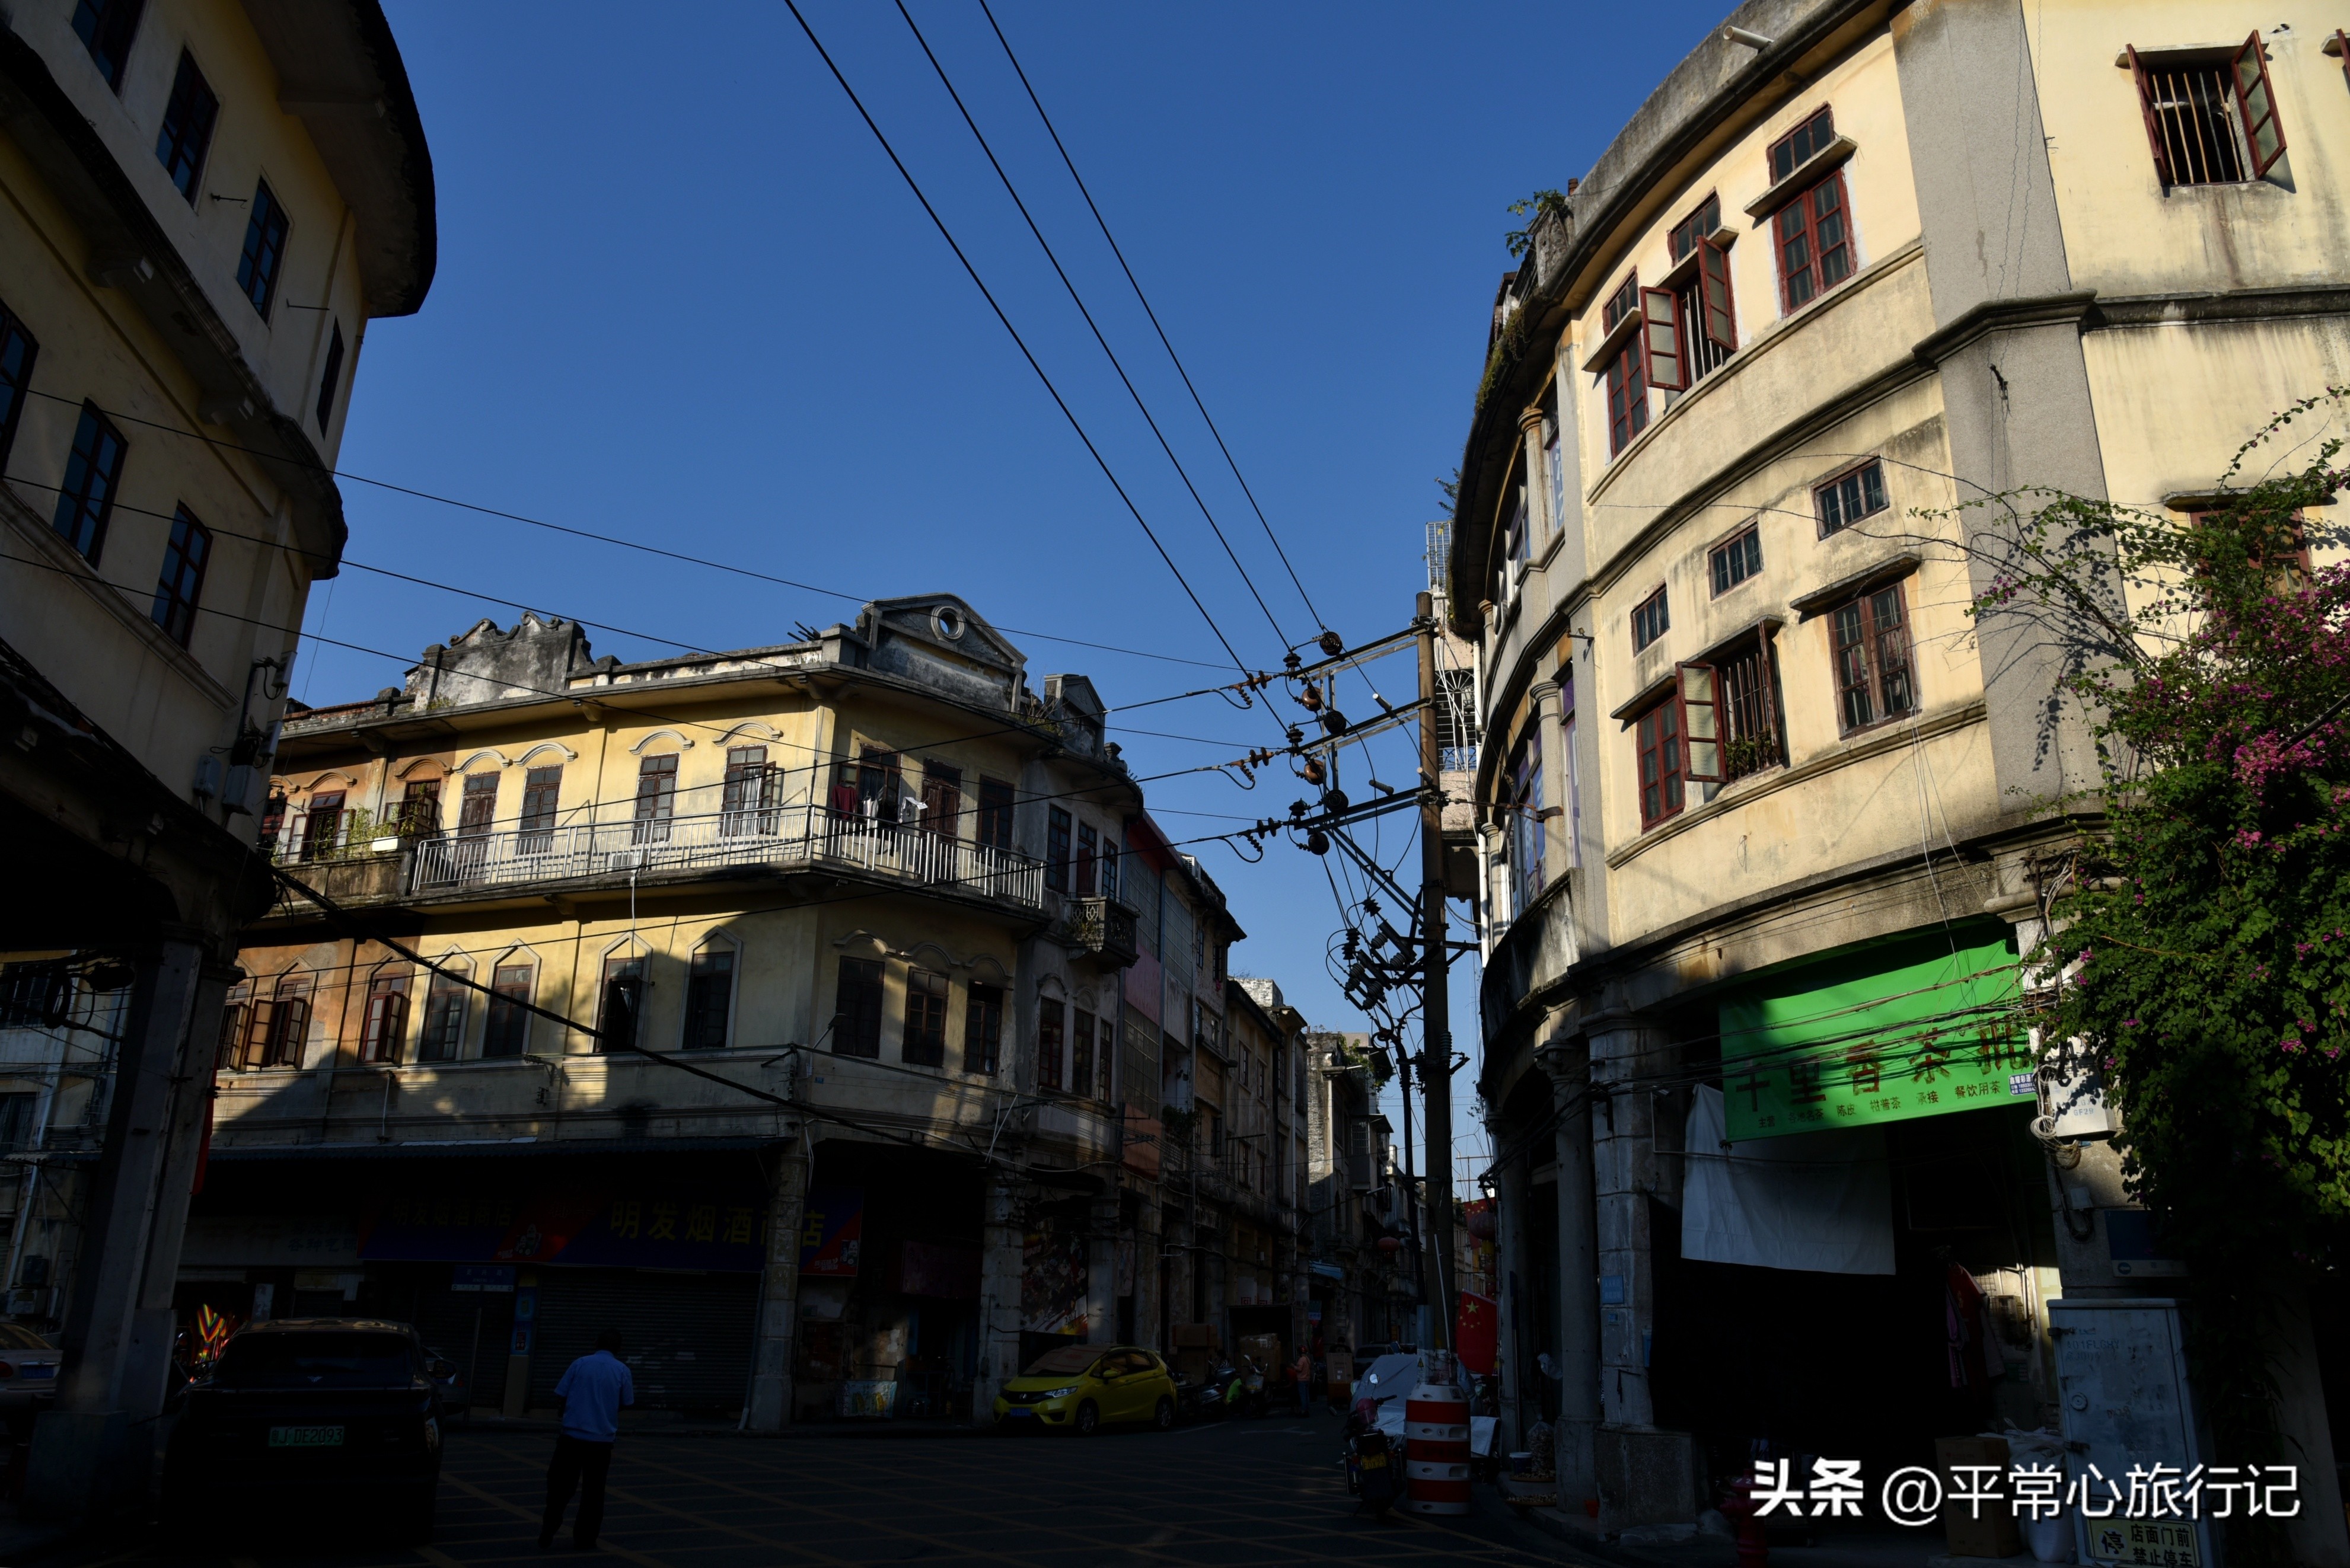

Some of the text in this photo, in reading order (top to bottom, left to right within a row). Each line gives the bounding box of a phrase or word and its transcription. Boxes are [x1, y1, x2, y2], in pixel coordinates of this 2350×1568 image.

[1758, 1081, 2001, 1128] 主营 各地名茶 陈皮 柑普茶 承接 餐饮用茶
[393, 1197, 514, 1227] 明发烟酒商店
[610, 1199, 825, 1248] 明发烟酒店
[2131, 1524, 2190, 1548] 店面门前
[2132, 1546, 2193, 1568] 禁止停车
